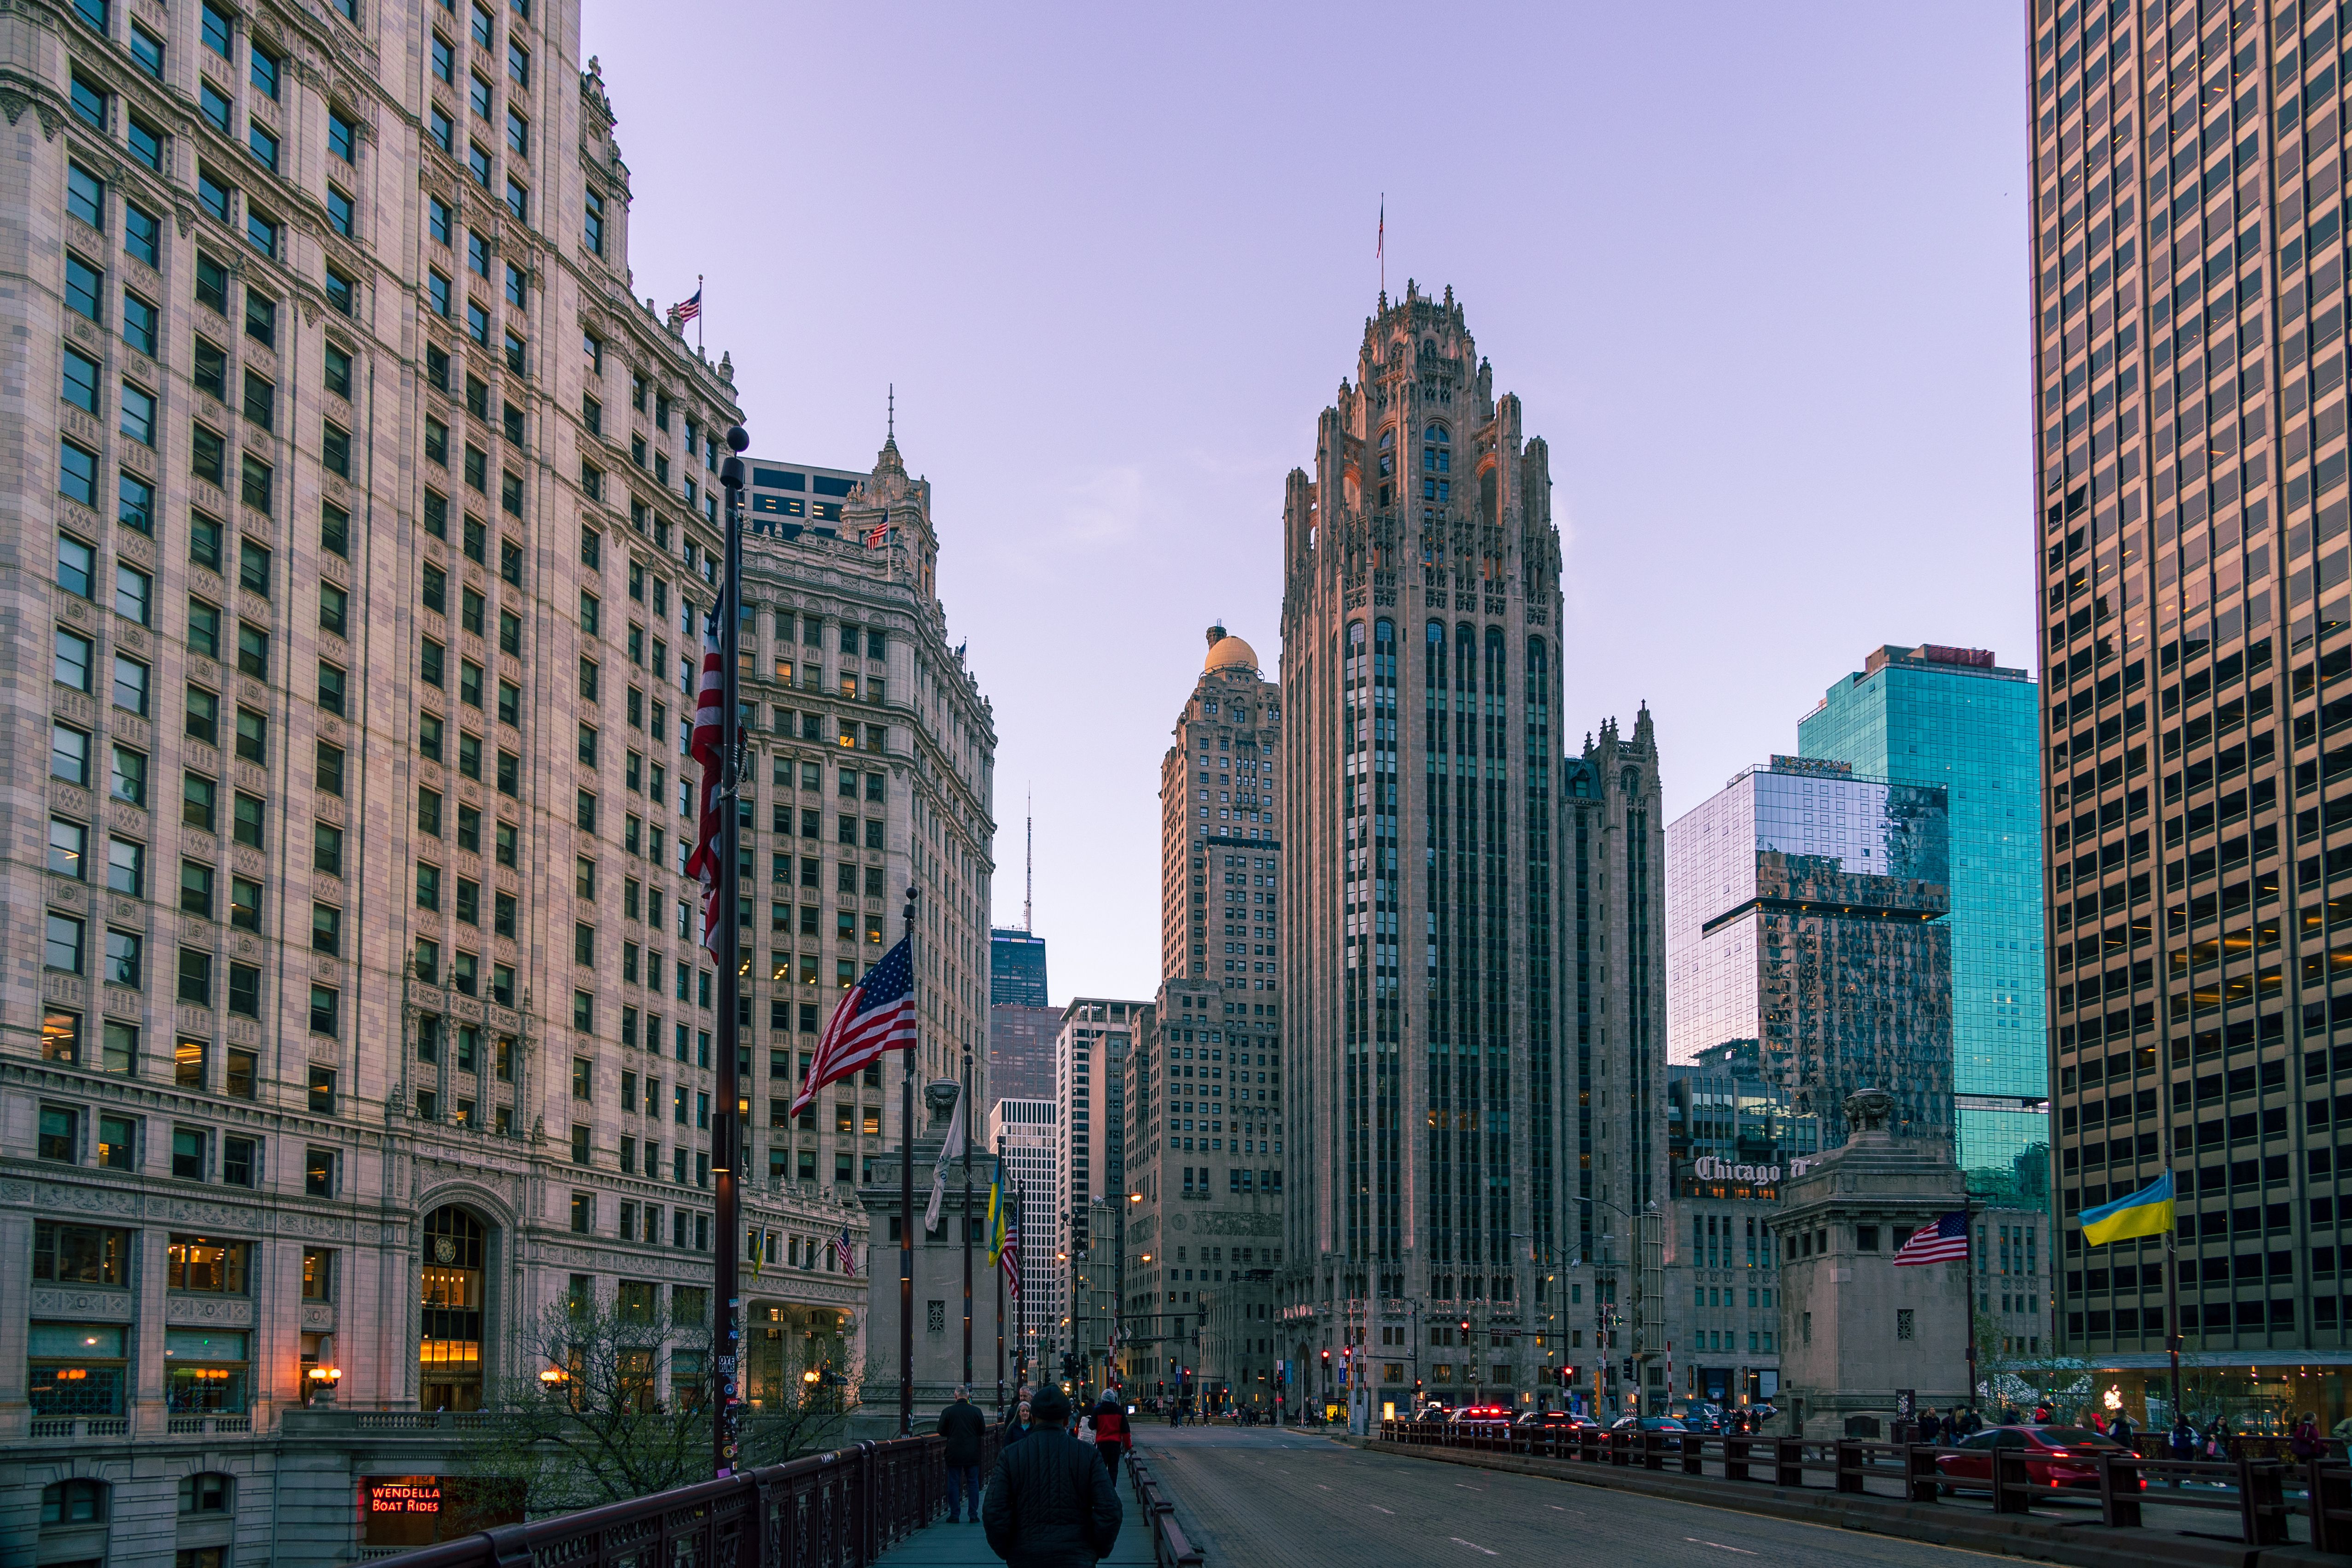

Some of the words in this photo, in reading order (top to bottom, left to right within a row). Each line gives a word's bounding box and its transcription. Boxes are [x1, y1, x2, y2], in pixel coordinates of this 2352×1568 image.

[1695, 1156, 1780, 1185] Chicago
[372, 1488, 440, 1498] WENDELLA
[372, 1499, 402, 1511] BOAT
[407, 1499, 439, 1511] RIDES
